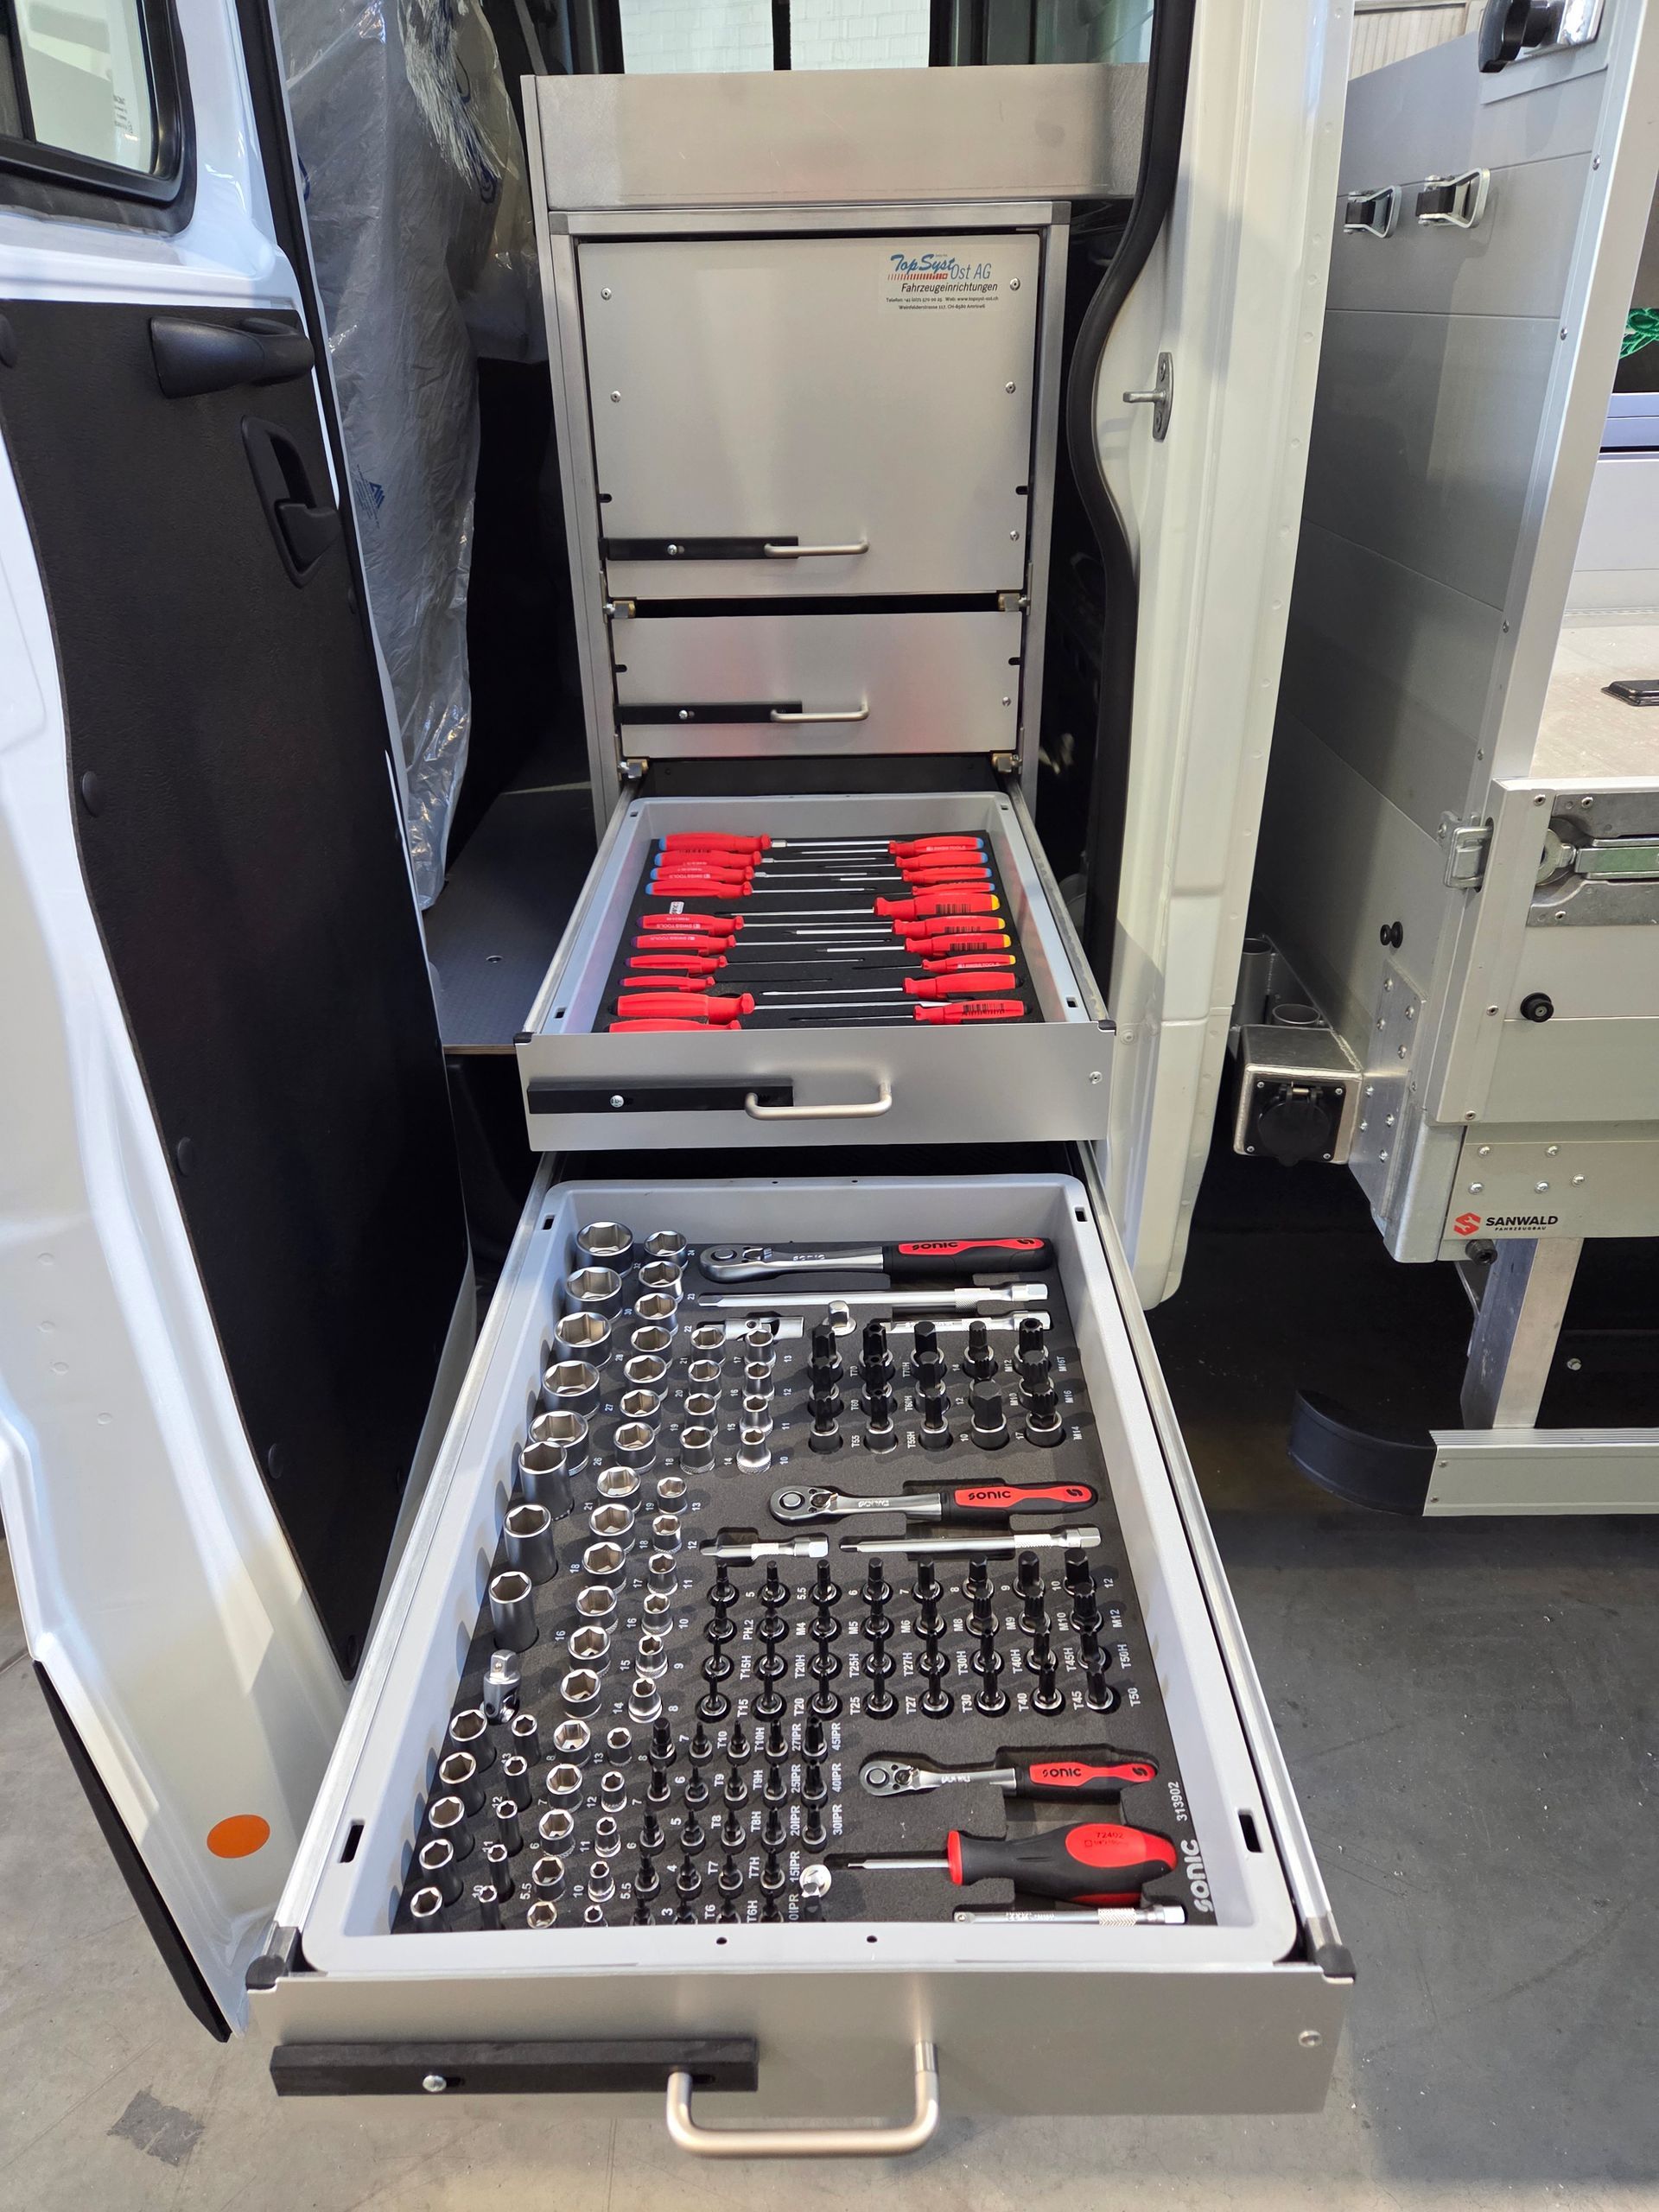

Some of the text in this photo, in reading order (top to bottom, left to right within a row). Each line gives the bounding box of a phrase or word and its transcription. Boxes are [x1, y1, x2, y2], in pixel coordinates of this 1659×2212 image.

[950, 263, 971, 280] Ost
[973, 263, 992, 279] AG
[901, 283, 998, 294] Fahrzeugeinrichtungen
[1486, 1216, 1558, 1226] SANWALD
[1004, 1359, 1013, 1372] M12
[1009, 1392, 1019, 1406] M10
[1064, 1390, 1074, 1403] M16
[907, 1431, 916, 1448] T55H
[960, 1433, 969, 1442] 10
[1071, 1426, 1083, 1440] M14
[851, 1435, 860, 1447] T55
[594, 1458, 602, 1466] 26
[665, 1458, 673, 1466] 18
[724, 1457, 732, 1465] 14
[780, 1456, 788, 1465] 10
[584, 1502, 594, 1510] 21
[645, 1503, 654, 1511] 19
[691, 1503, 701, 1511] 13
[688, 1541, 697, 1550] 12
[569, 1564, 580, 1573] 18
[633, 1579, 643, 1588] 17
[683, 1580, 693, 1589] 11
[1051, 1580, 1062, 1591] 10
[1103, 1578, 1114, 1588] 12
[797, 1587, 806, 1600] 5.5
[626, 1618, 637, 1629] 16
[678, 1618, 689, 1629] 10
[900, 1619, 911, 1633] M6
[953, 1618, 963, 1632] M8
[1006, 1616, 1016, 1630] M9
[1057, 1611, 1070, 1631] M10
[1109, 1609, 1122, 1628] M12
[555, 1630, 565, 1641] 16
[742, 1619, 753, 1640] PH.2
[796, 1622, 805, 1636] M4
[849, 1621, 859, 1635] M5
[957, 1650, 969, 1675] T30H
[1010, 1649, 1023, 1675] T40H
[1063, 1647, 1077, 1672] T45H
[1117, 1643, 1131, 1669] T50H
[620, 1660, 630, 1671] 15
[740, 1656, 752, 1680] T15H
[795, 1655, 805, 1679] T20H
[849, 1653, 860, 1678] T25H
[903, 1652, 913, 1677] T27H
[961, 1694, 973, 1713] T30
[1017, 1693, 1029, 1713] T40
[1071, 1690, 1084, 1710] T45
[1128, 1687, 1141, 1707] T50
[613, 1702, 623, 1714] 14
[737, 1699, 748, 1717] T15
[794, 1697, 804, 1716] T20
[850, 1696, 861, 1715] T25
[906, 1696, 917, 1715] T27
[717, 1731, 728, 1749] T10
[754, 1726, 765, 1752] T10H
[791, 1723, 802, 1751] 27IPR
[831, 1722, 841, 1751] 45IPR
[594, 1752, 603, 1764] 13
[714, 1773, 725, 1787] T9
[753, 1770, 763, 1790] T9H
[791, 1764, 801, 1793] 25IPR
[832, 1763, 842, 1793] 40IPR
[492, 1796, 503, 1808] 12
[587, 1796, 597, 1808] 12
[1168, 1781, 1188, 1822] 313902
[711, 1815, 721, 1829] T8
[751, 1811, 761, 1832] T8H
[791, 1805, 800, 1836] 20IPR
[832, 1804, 843, 1835] 30IPR
[580, 1840, 590, 1853] 11
[708, 1860, 719, 1875] T7
[749, 1856, 760, 1878] T7H
[790, 1851, 800, 1883] 15IPR
[520, 1883, 532, 1900] 5.5
[573, 1885, 584, 1897] 10
[620, 1883, 632, 1899] 5.5
[704, 1904, 715, 1919] T6
[747, 1900, 758, 1923] T6H
[789, 1893, 799, 1923] 0IPR
